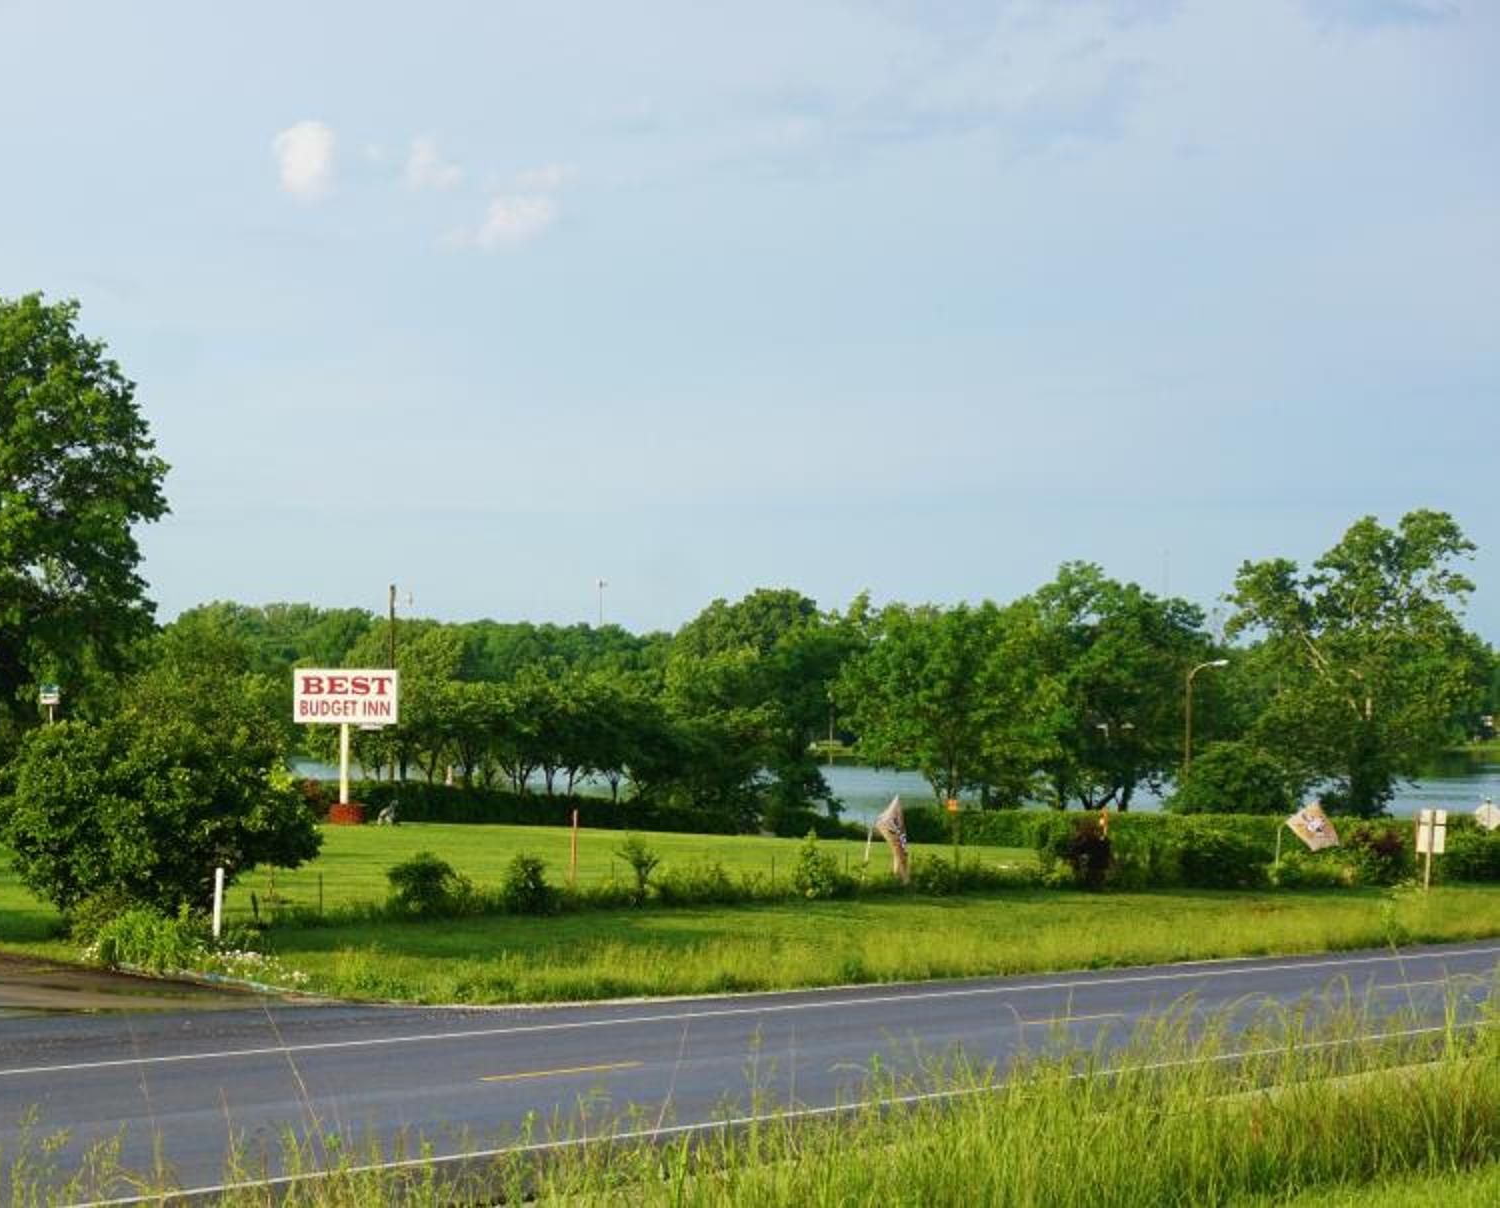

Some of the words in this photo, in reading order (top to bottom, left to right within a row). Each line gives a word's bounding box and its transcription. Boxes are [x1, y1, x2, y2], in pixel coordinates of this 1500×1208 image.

[301, 676, 392, 695] BEST
[300, 700, 358, 716] BUDGET
[363, 700, 391, 716] INN
